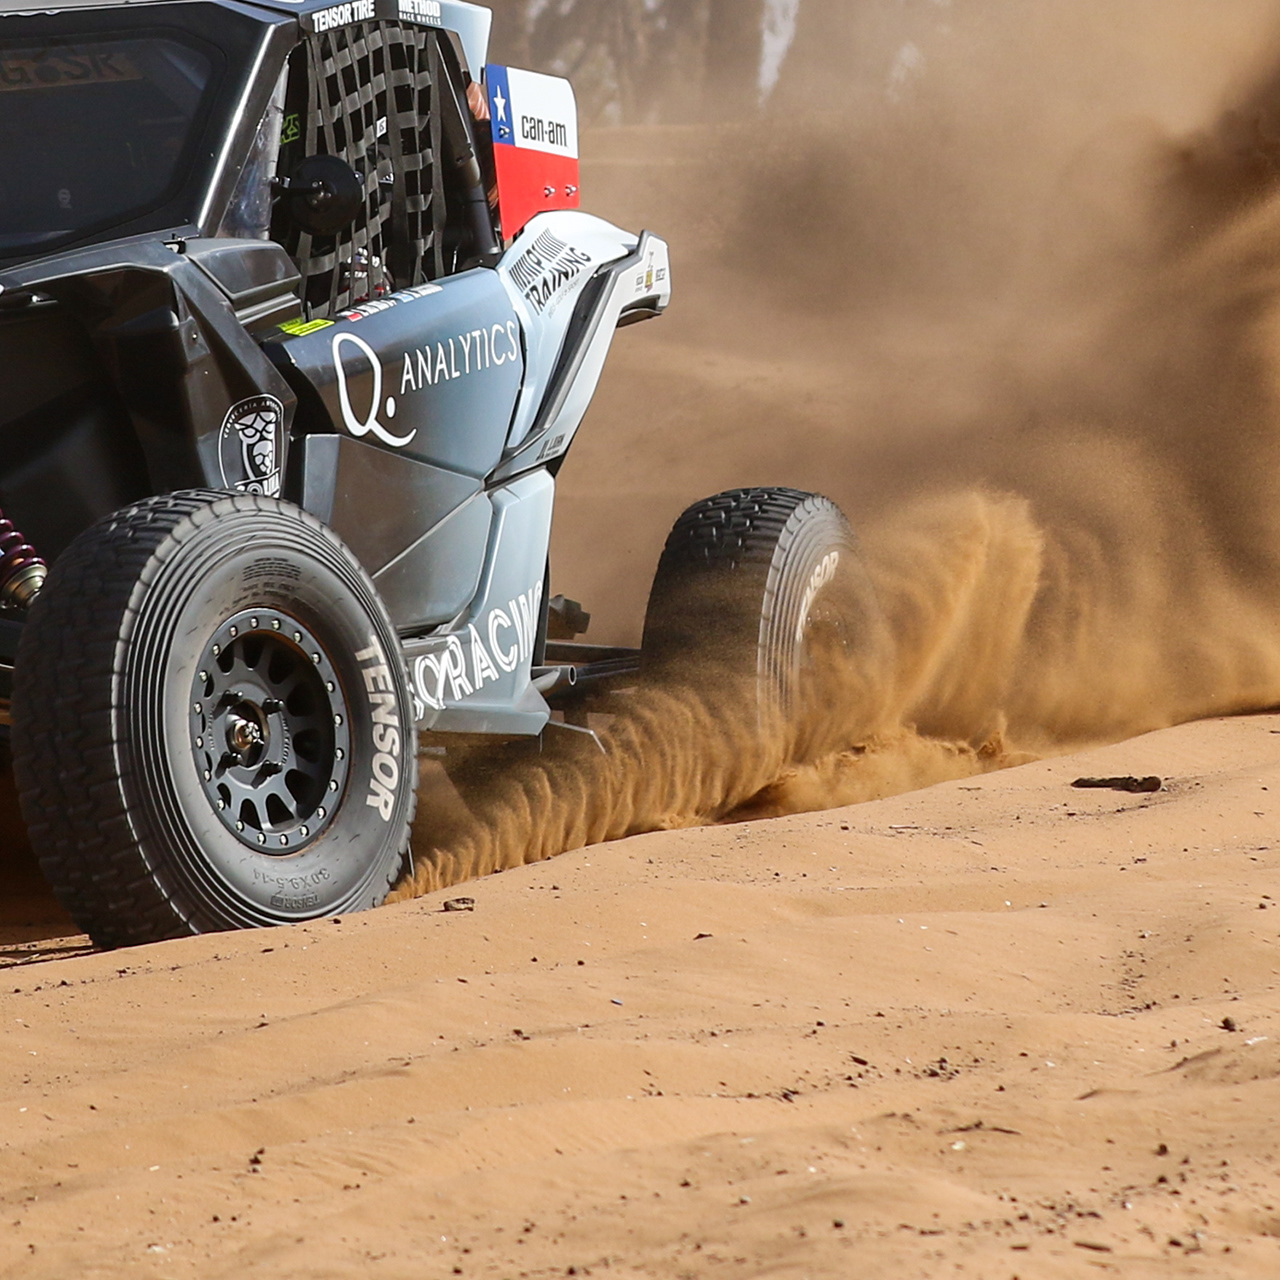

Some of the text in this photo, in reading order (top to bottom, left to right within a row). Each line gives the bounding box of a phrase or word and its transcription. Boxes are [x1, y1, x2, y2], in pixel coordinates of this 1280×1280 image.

[312, 4, 352, 33] TENSOR
[525, 247, 592, 316] TRAINING
[400, 320, 518, 395] ANALYTICS
[354, 634, 401, 822] TENSOR
